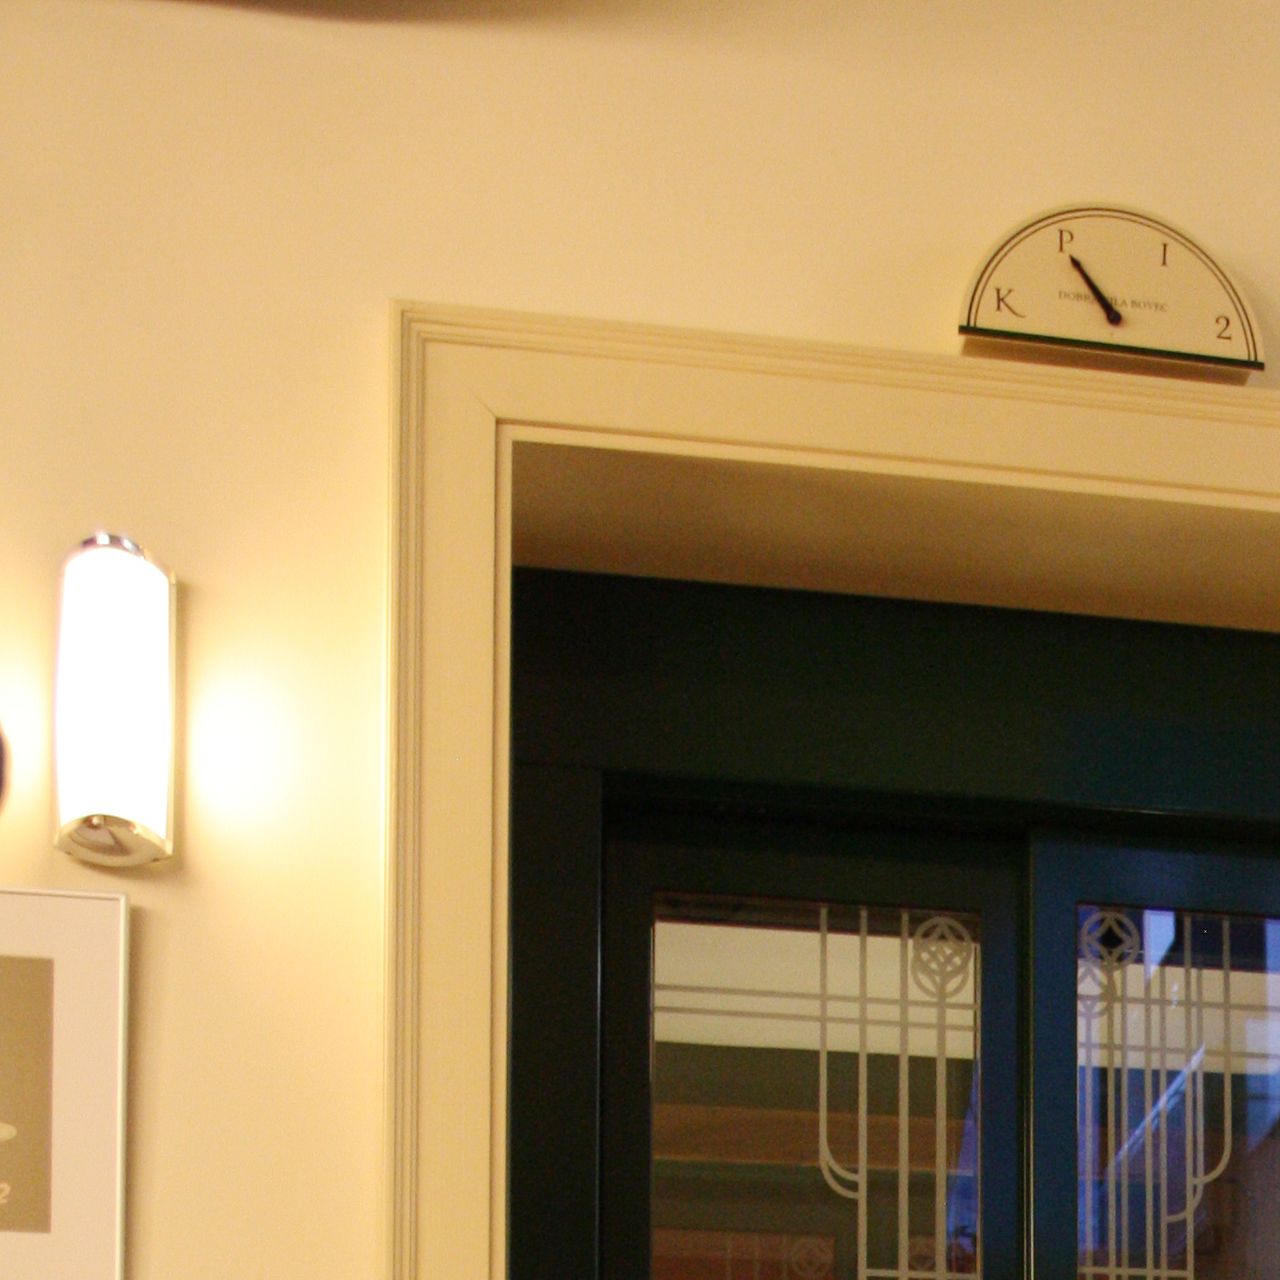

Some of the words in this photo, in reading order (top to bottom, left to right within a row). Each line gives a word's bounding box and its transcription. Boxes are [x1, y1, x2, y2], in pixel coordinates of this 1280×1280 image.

[1057, 229, 1074, 253] P
[995, 288, 1026, 319] K
[1215, 315, 1232, 341] 2
